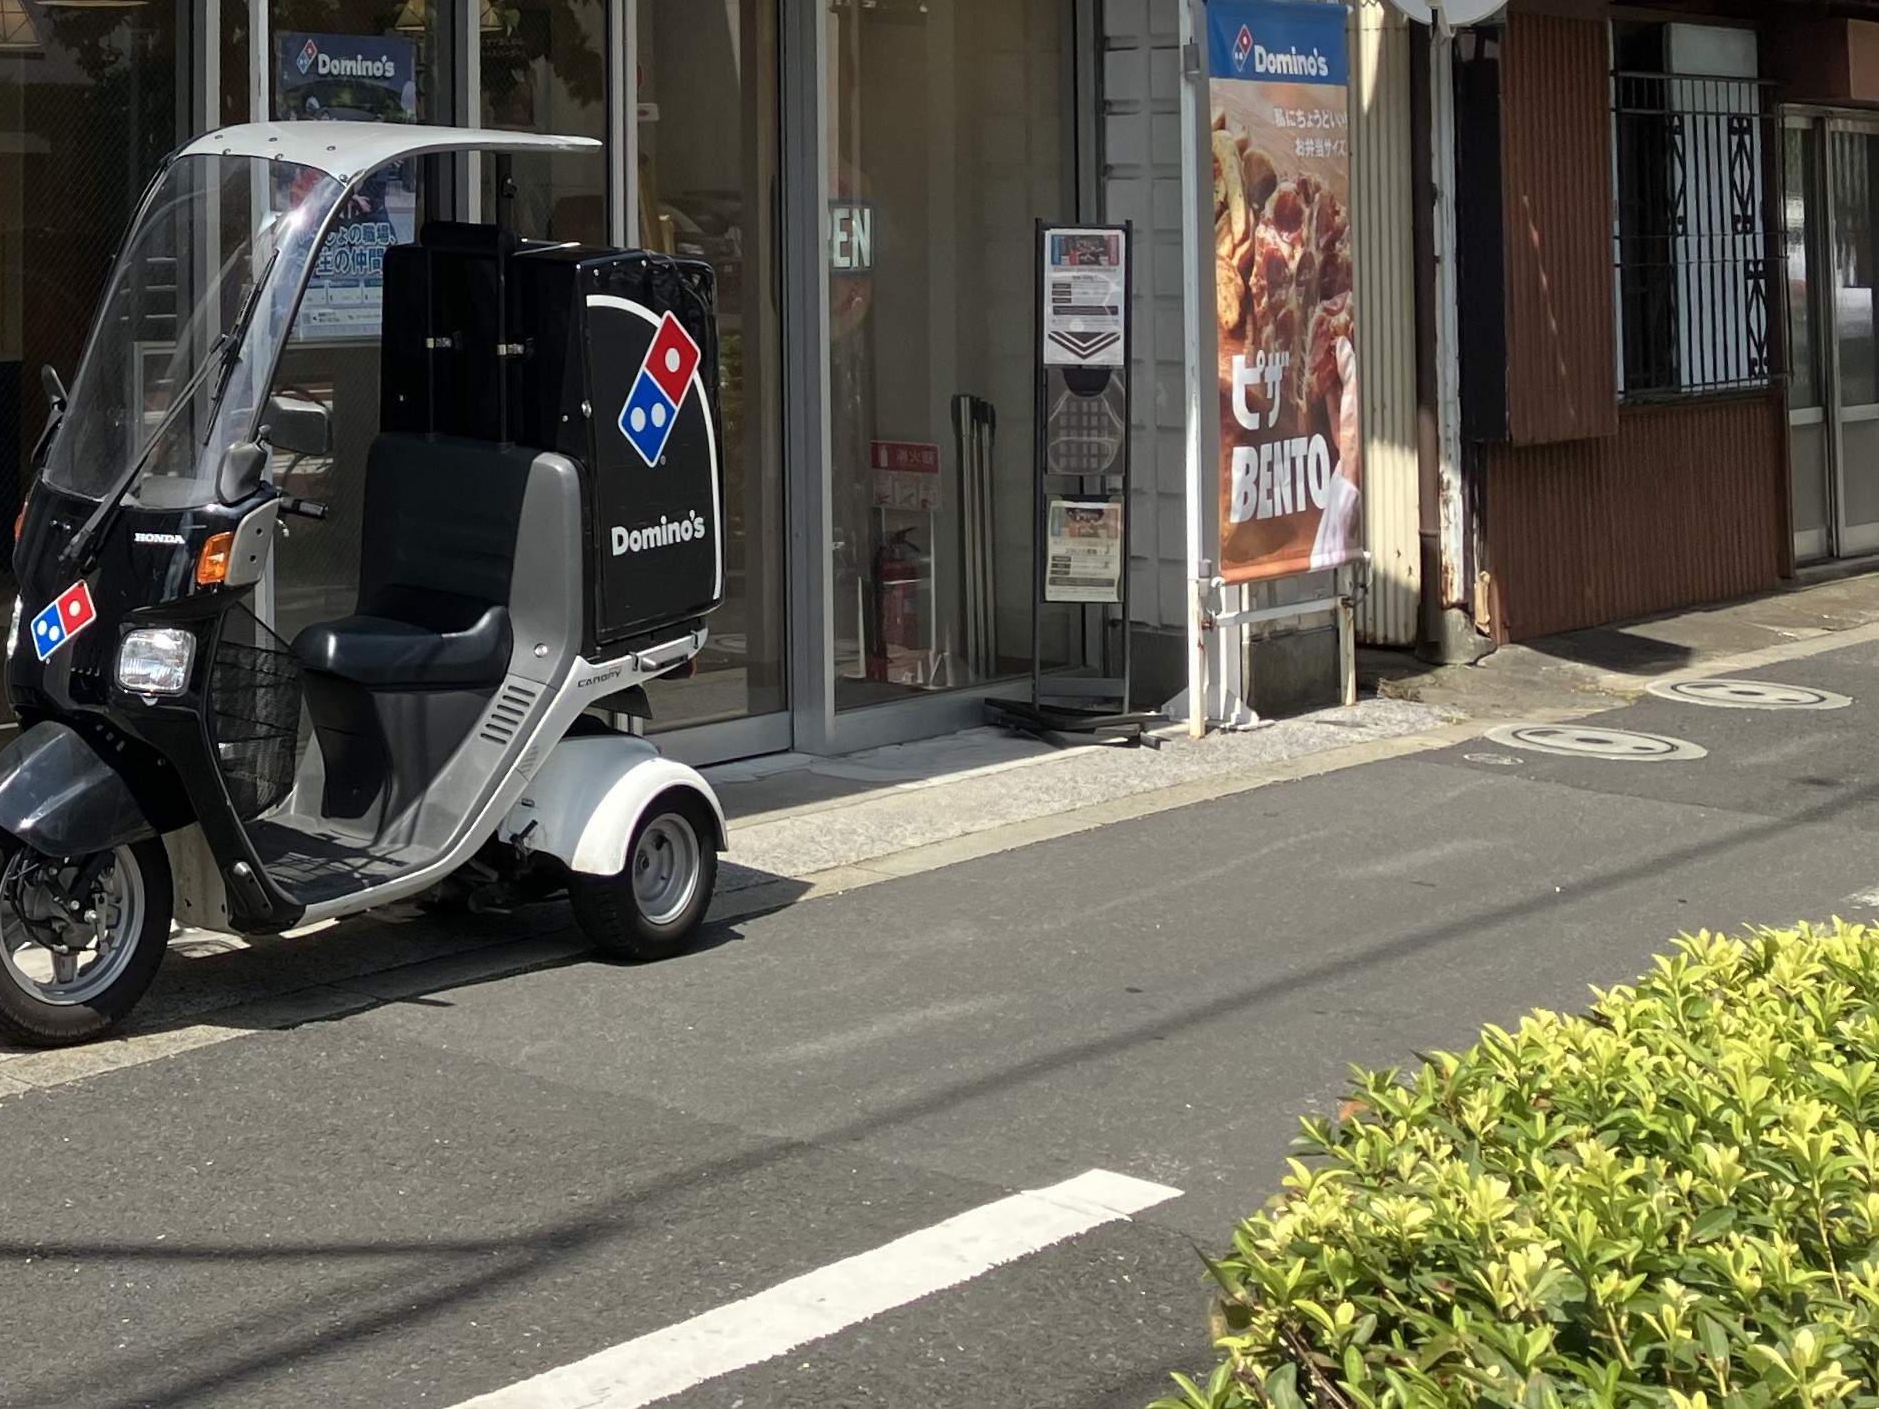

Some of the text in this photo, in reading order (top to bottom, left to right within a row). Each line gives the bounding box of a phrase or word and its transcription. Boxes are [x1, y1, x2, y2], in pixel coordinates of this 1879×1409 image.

[317, 53, 395, 78] Domino's
[1254, 45, 1329, 77] Domino's
[1231, 349, 1290, 431] ピザ
[1229, 433, 1331, 524] BENTO
[133, 532, 187, 545] HONDA
[611, 509, 706, 557] Domino's
[577, 670, 622, 688] CANOPY
